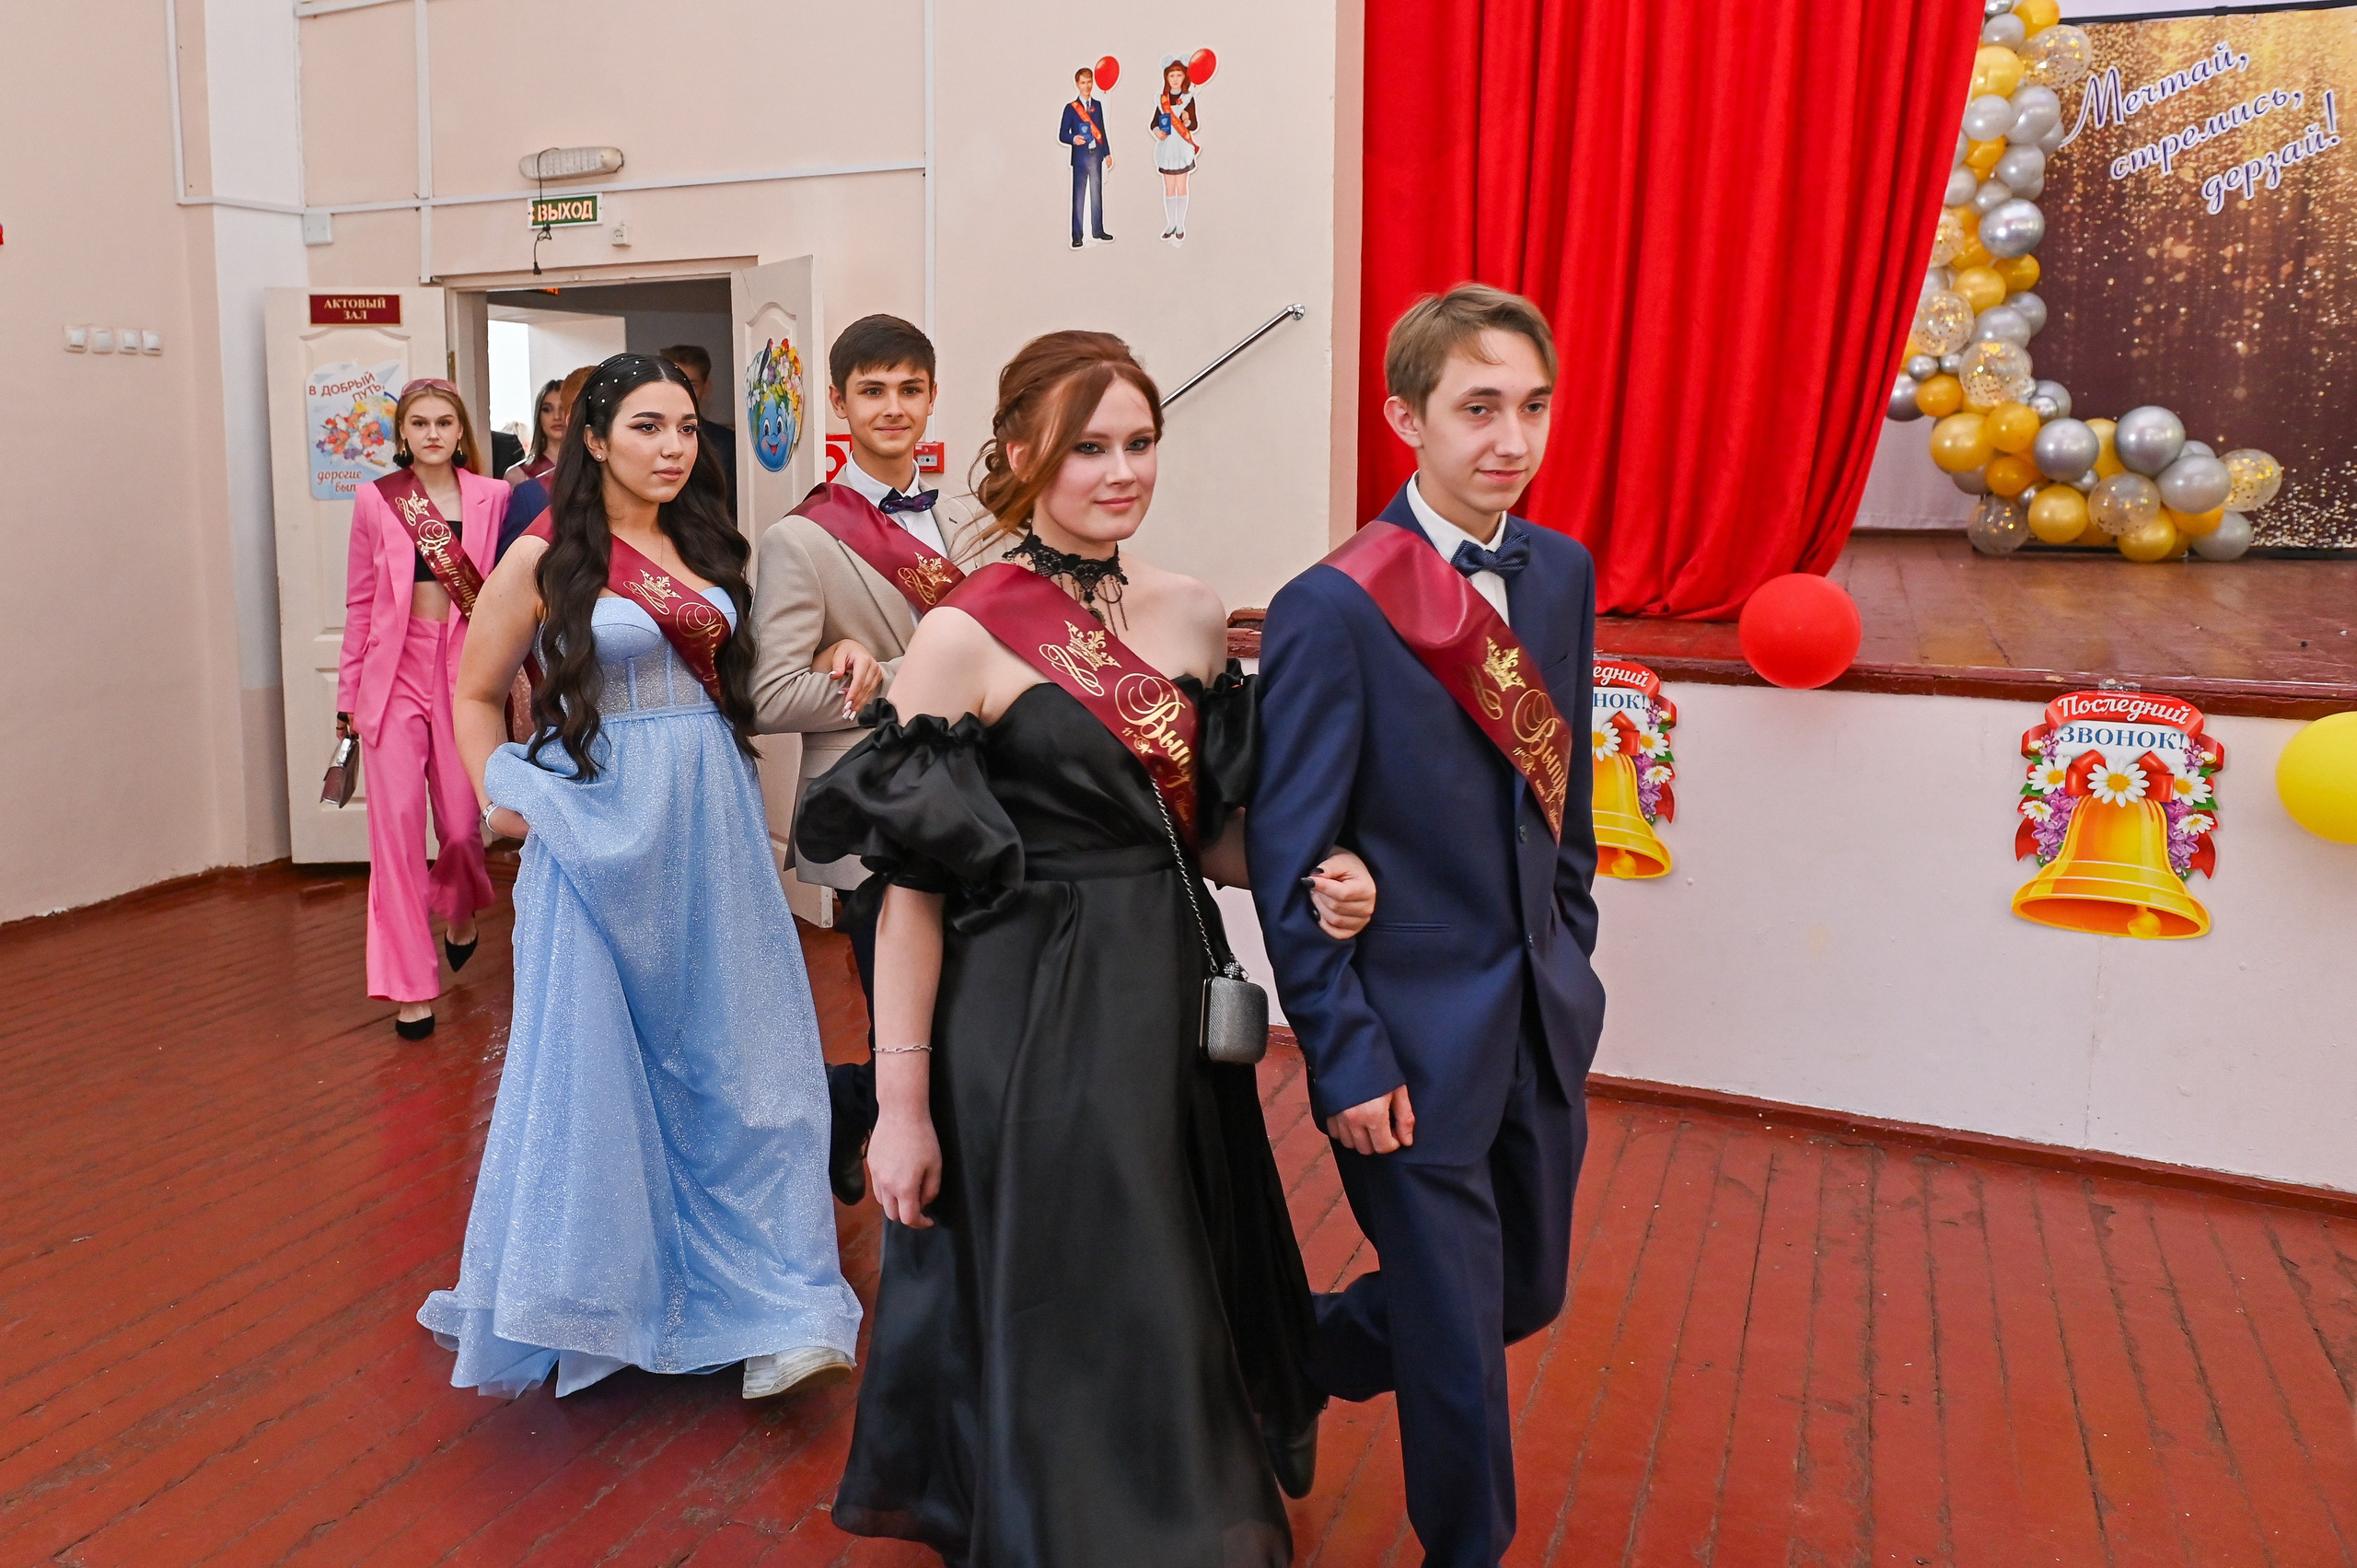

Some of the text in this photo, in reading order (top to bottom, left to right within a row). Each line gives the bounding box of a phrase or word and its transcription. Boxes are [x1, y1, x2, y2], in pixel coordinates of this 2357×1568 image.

[2058, 41, 2249, 148] Мечтай,
[2110, 89, 2303, 180] стремись,
[2201, 88, 2340, 215] дерзай!
[538, 200, 594, 222] ВЫХОД
[323, 296, 387, 308] АКТОВЫЙ
[343, 309, 367, 320] ЗАЛ
[308, 371, 376, 397] В ДОБРЫЙ
[317, 470, 363, 485] дорогие
[2057, 694, 2191, 725] Последний
[2059, 726, 2186, 750] ЗВОНОК!
